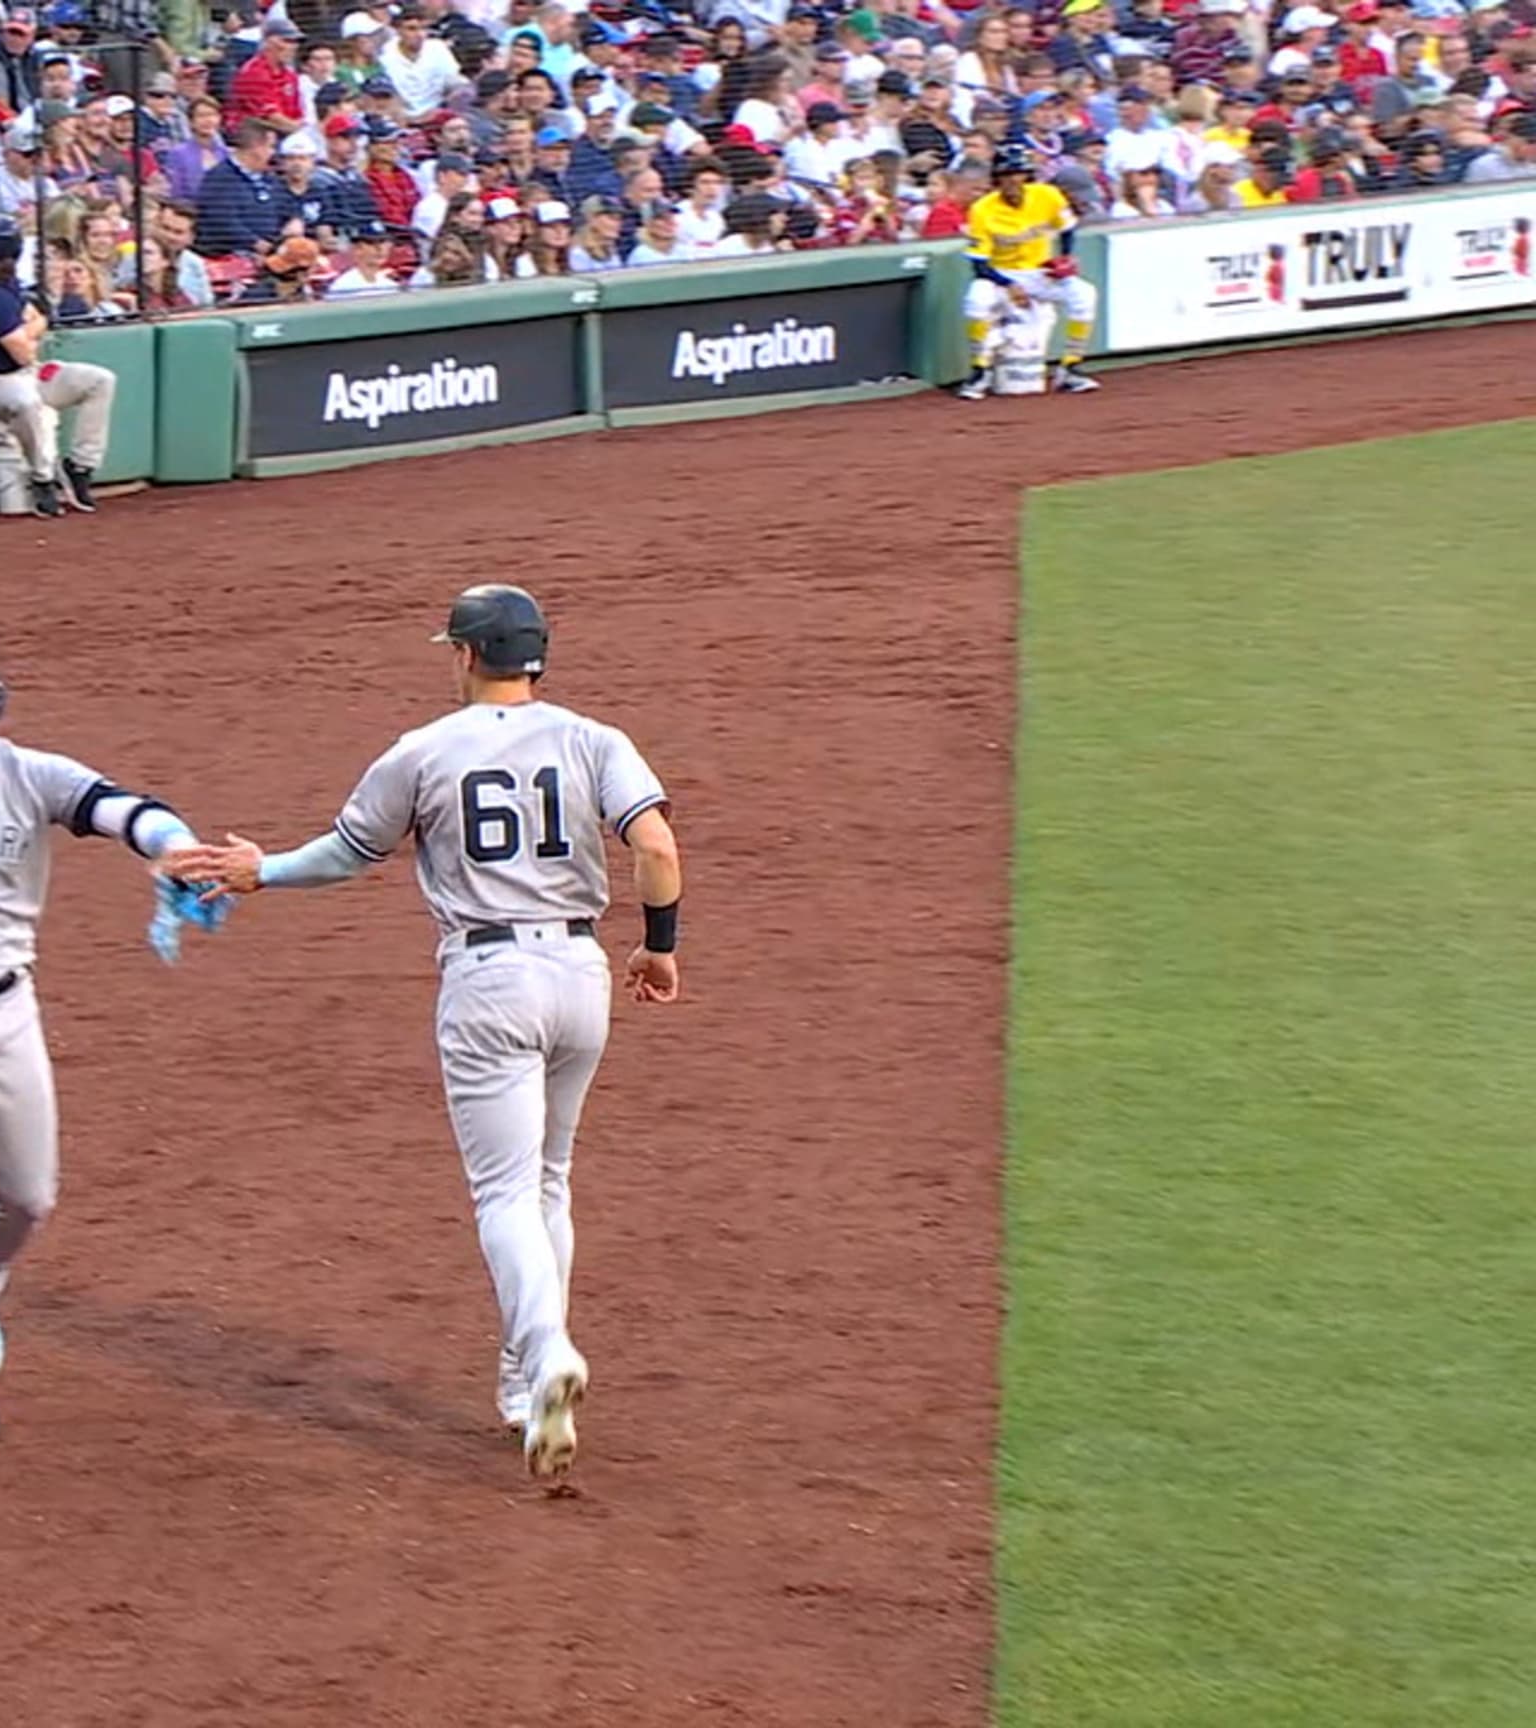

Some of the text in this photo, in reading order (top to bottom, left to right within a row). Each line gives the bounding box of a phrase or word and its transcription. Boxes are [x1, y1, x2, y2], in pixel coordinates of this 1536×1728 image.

[1301, 222, 1413, 287] TRULY
[672, 317, 837, 385] Aspiration
[322, 357, 499, 429] Aspiration
[458, 764, 572, 864] 61
